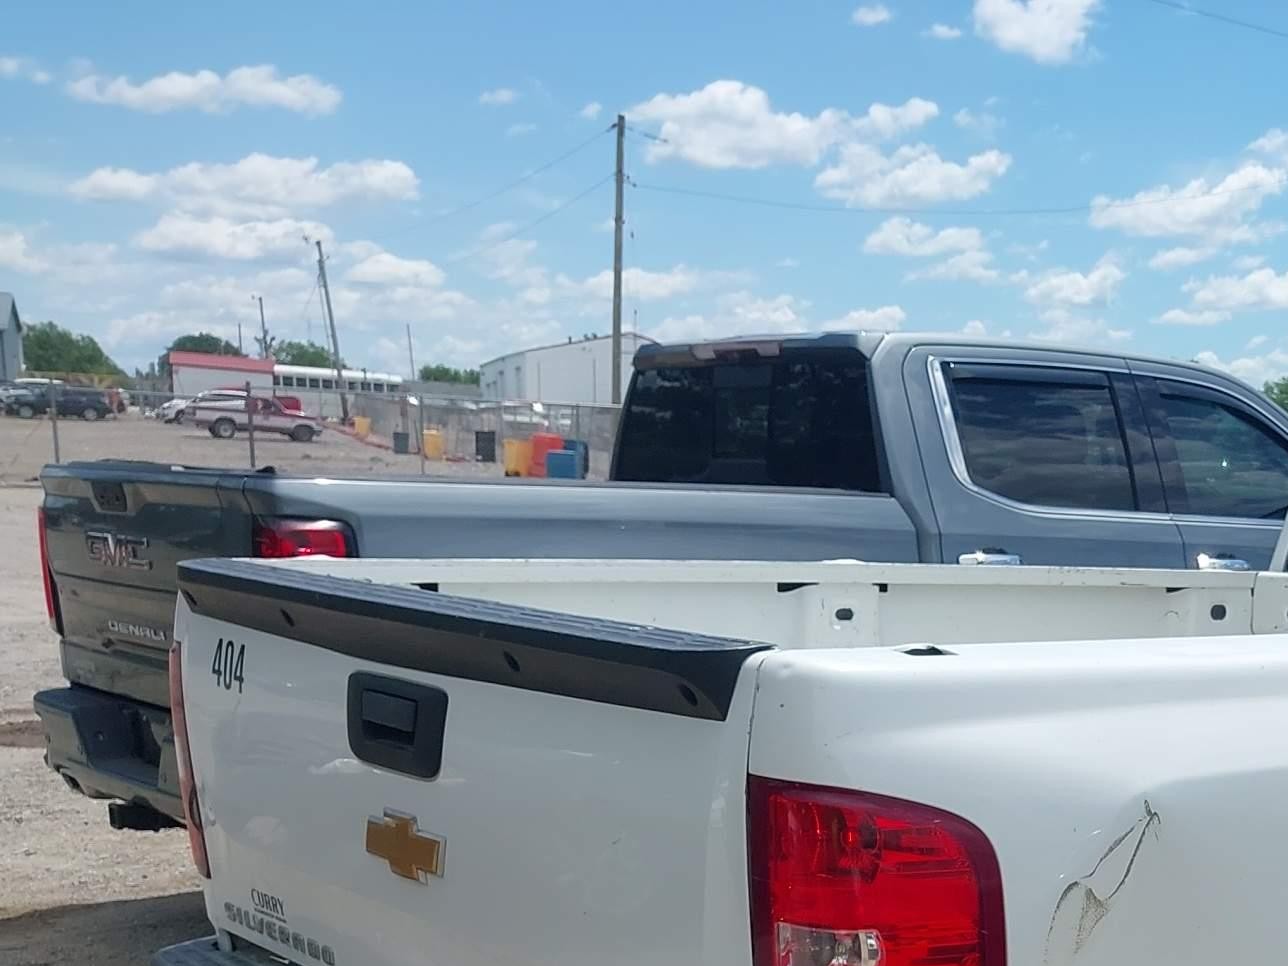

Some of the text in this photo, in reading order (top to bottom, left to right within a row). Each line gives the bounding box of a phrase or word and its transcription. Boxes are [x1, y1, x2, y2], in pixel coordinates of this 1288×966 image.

[86, 531, 152, 570] GMC
[108, 619, 166, 641] DENALI
[212, 637, 246, 694] 404
[251, 888, 285, 917] CURRY
